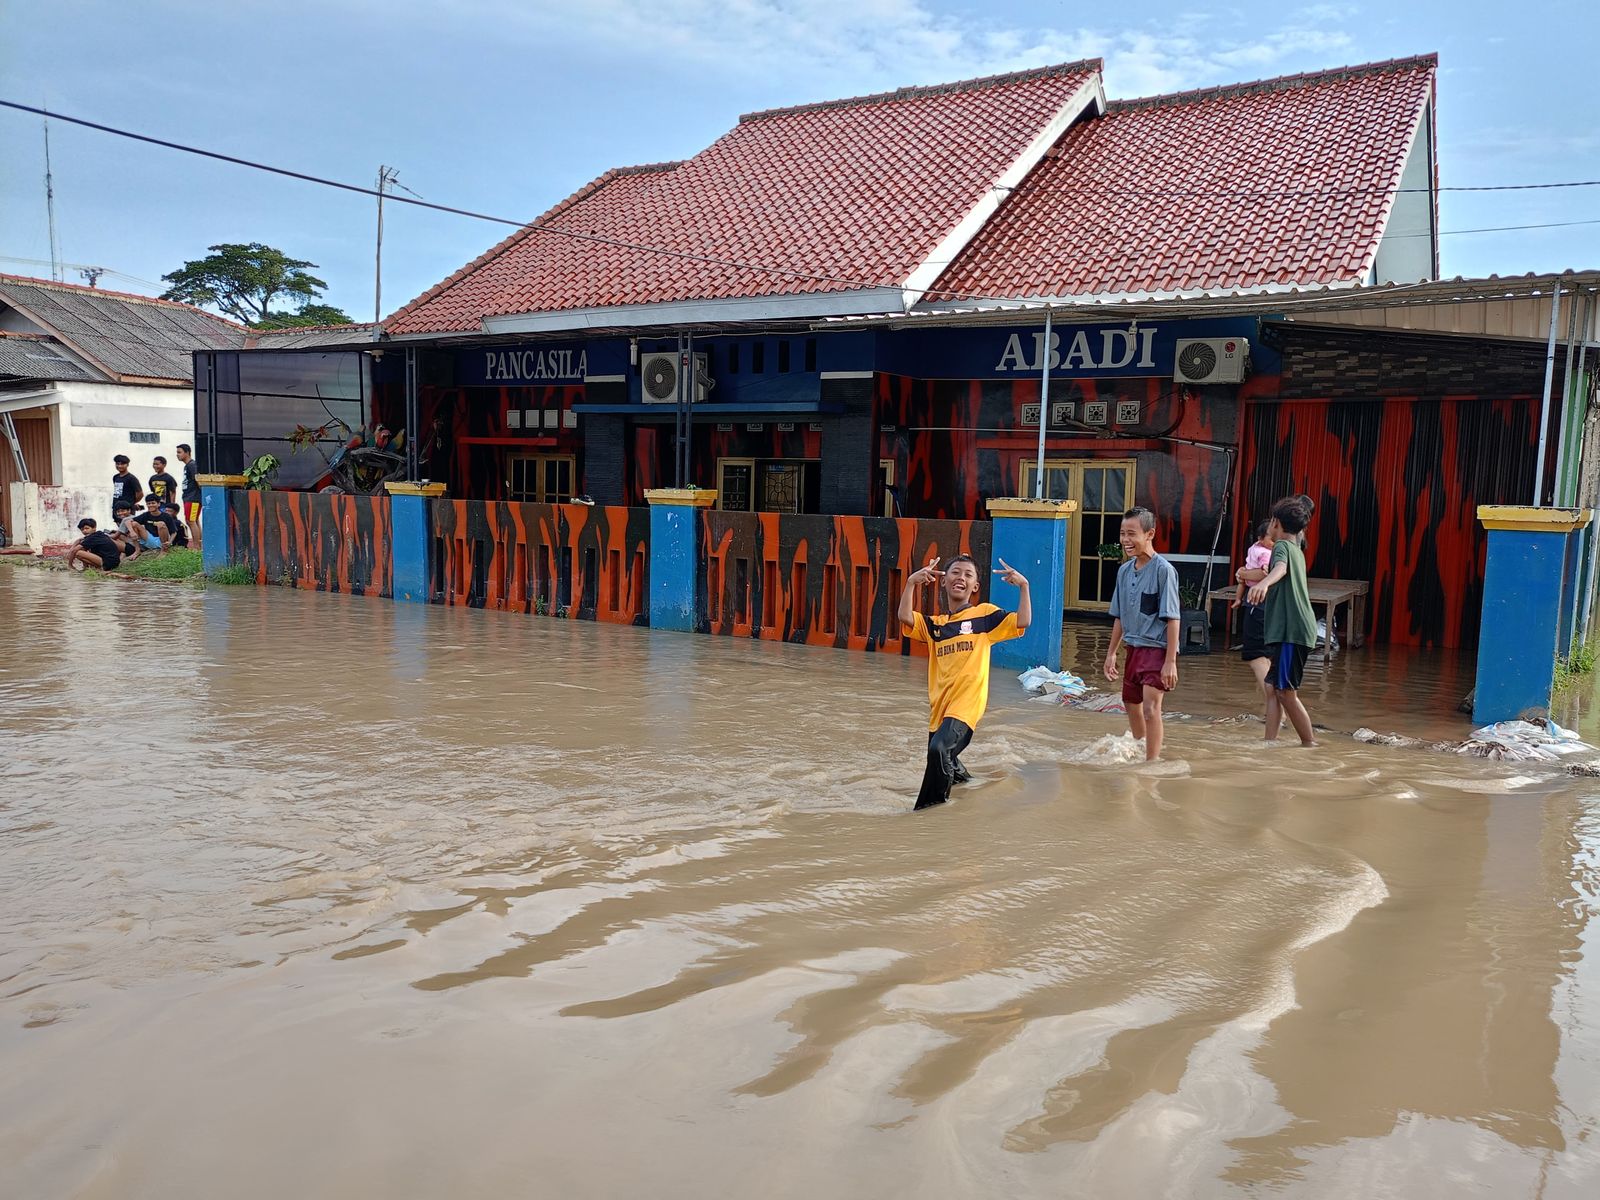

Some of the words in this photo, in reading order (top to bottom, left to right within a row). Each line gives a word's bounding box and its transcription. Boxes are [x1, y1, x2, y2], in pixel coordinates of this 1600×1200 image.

[995, 328, 1157, 370] ABADI
[485, 350, 587, 379] PANCASILA
[956, 641, 973, 652] MUDA
